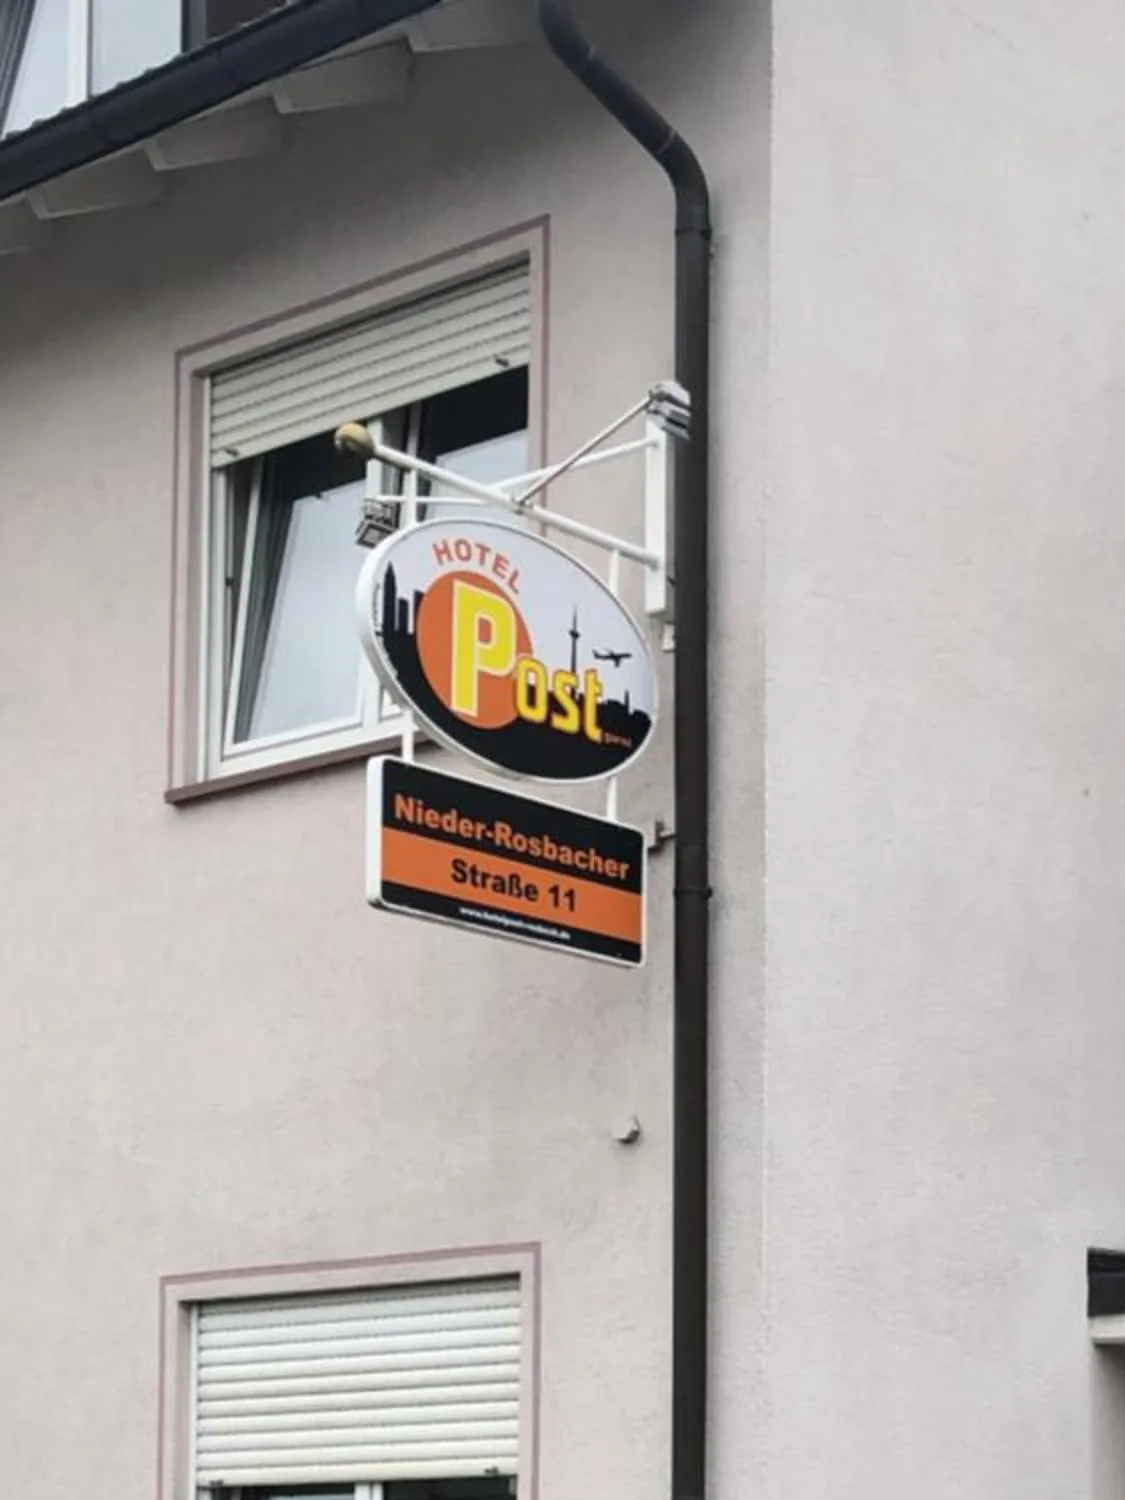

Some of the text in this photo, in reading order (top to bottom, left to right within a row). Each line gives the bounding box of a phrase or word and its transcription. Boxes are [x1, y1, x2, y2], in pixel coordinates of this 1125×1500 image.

[432, 538, 523, 595] HOTEL
[450, 577, 604, 744] Post
[393, 793, 631, 881] Nieder-Rosbacher
[450, 857, 576, 913] Straße 11
